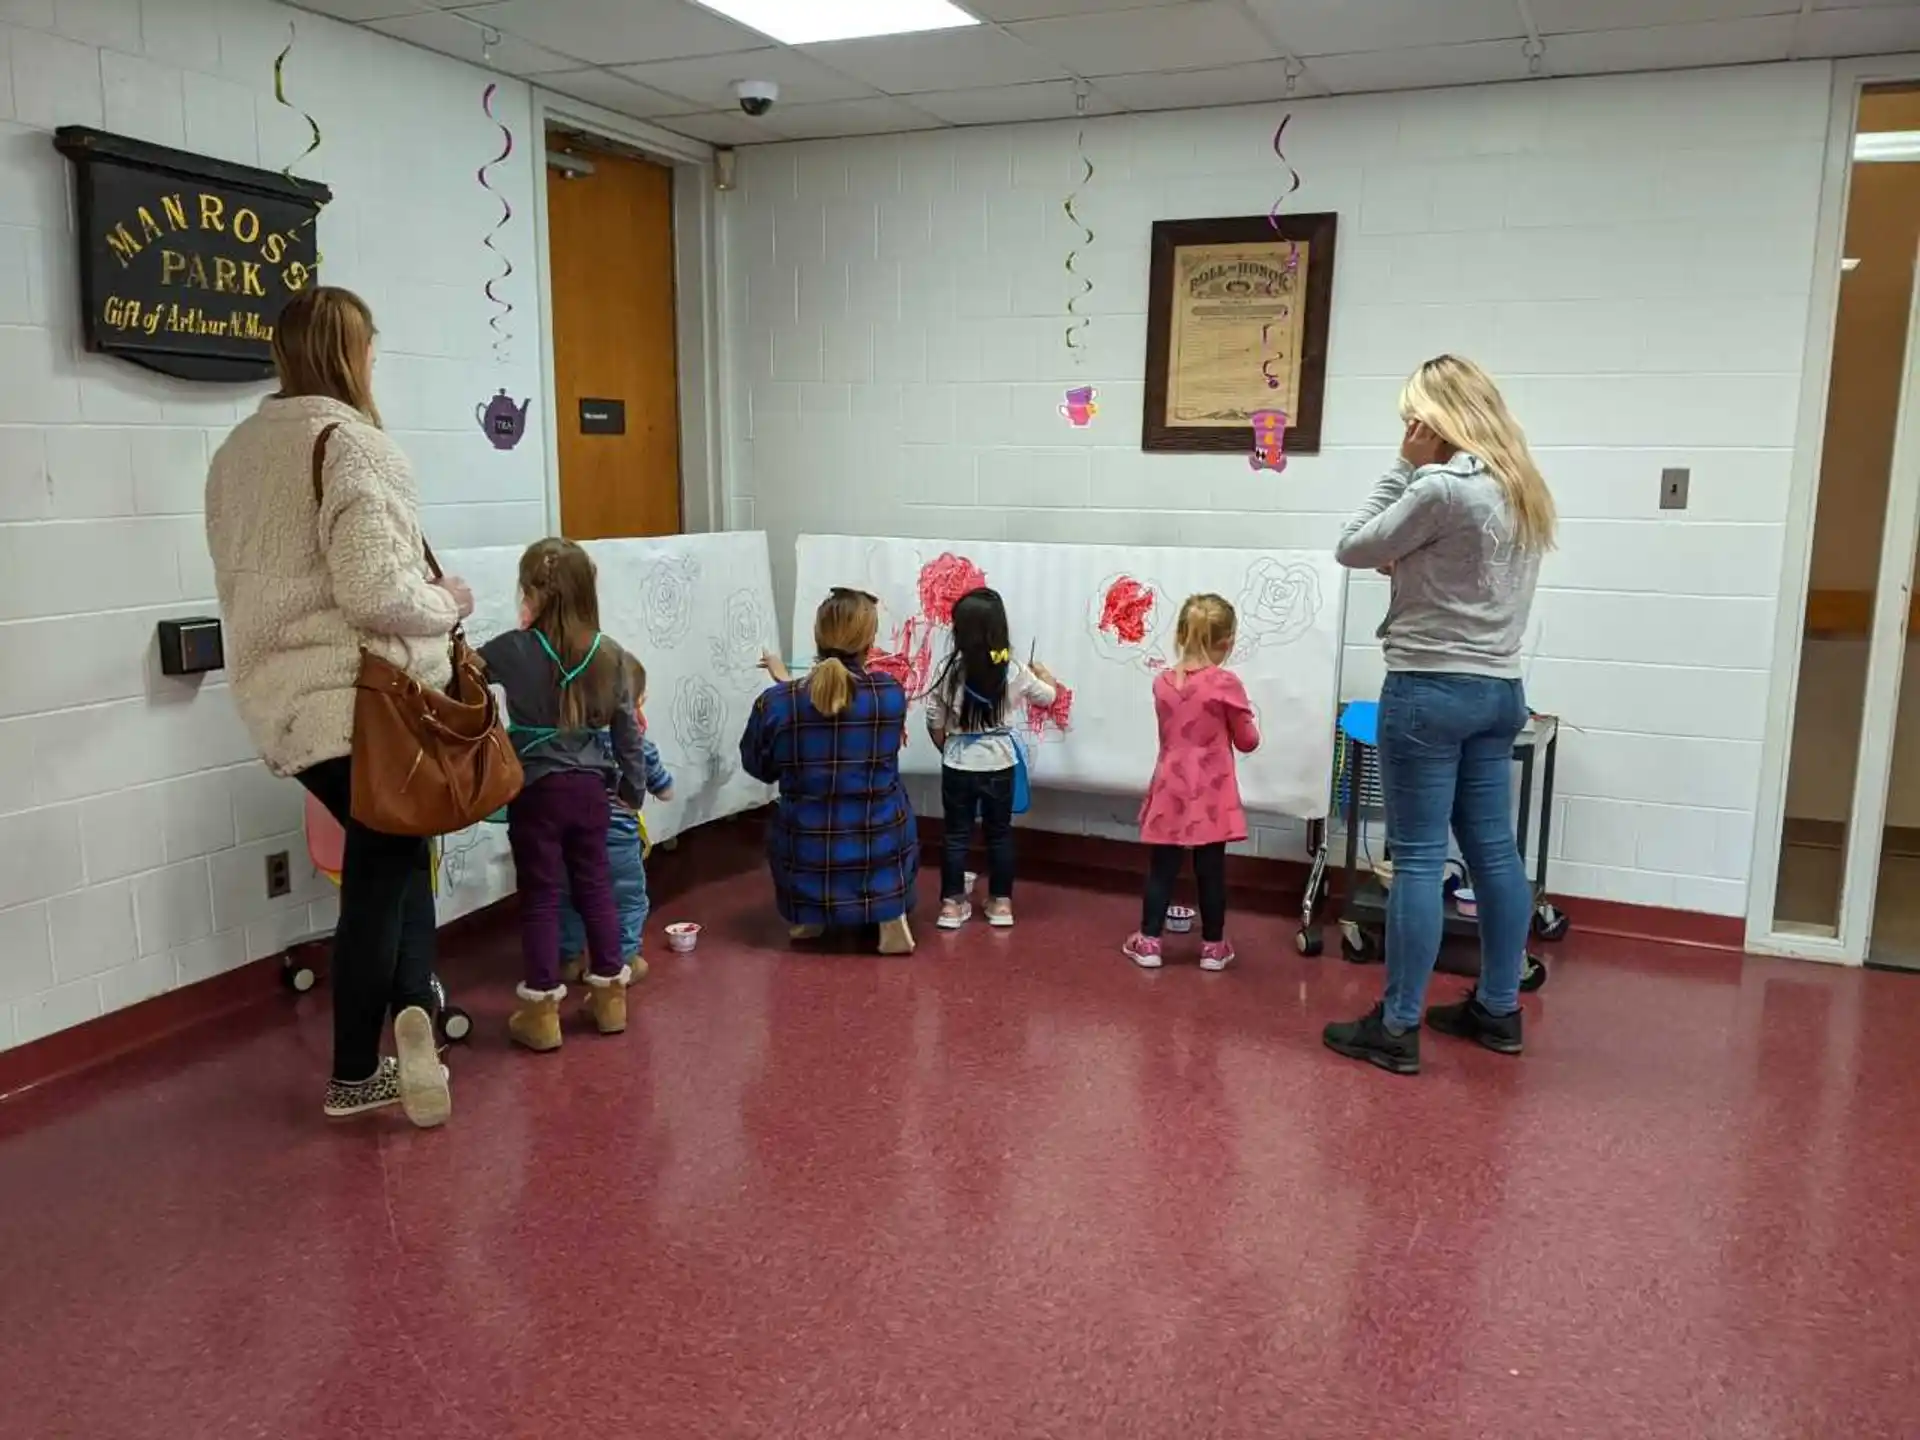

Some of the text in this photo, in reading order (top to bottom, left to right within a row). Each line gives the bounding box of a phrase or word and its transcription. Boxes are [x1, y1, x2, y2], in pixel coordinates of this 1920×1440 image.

[105, 192, 309, 291] MANROSE
[159, 249, 265, 297] PARK
[104, 296, 141, 331] Gift
[143, 303, 165, 335] of
[165, 304, 228, 336] Arthur
